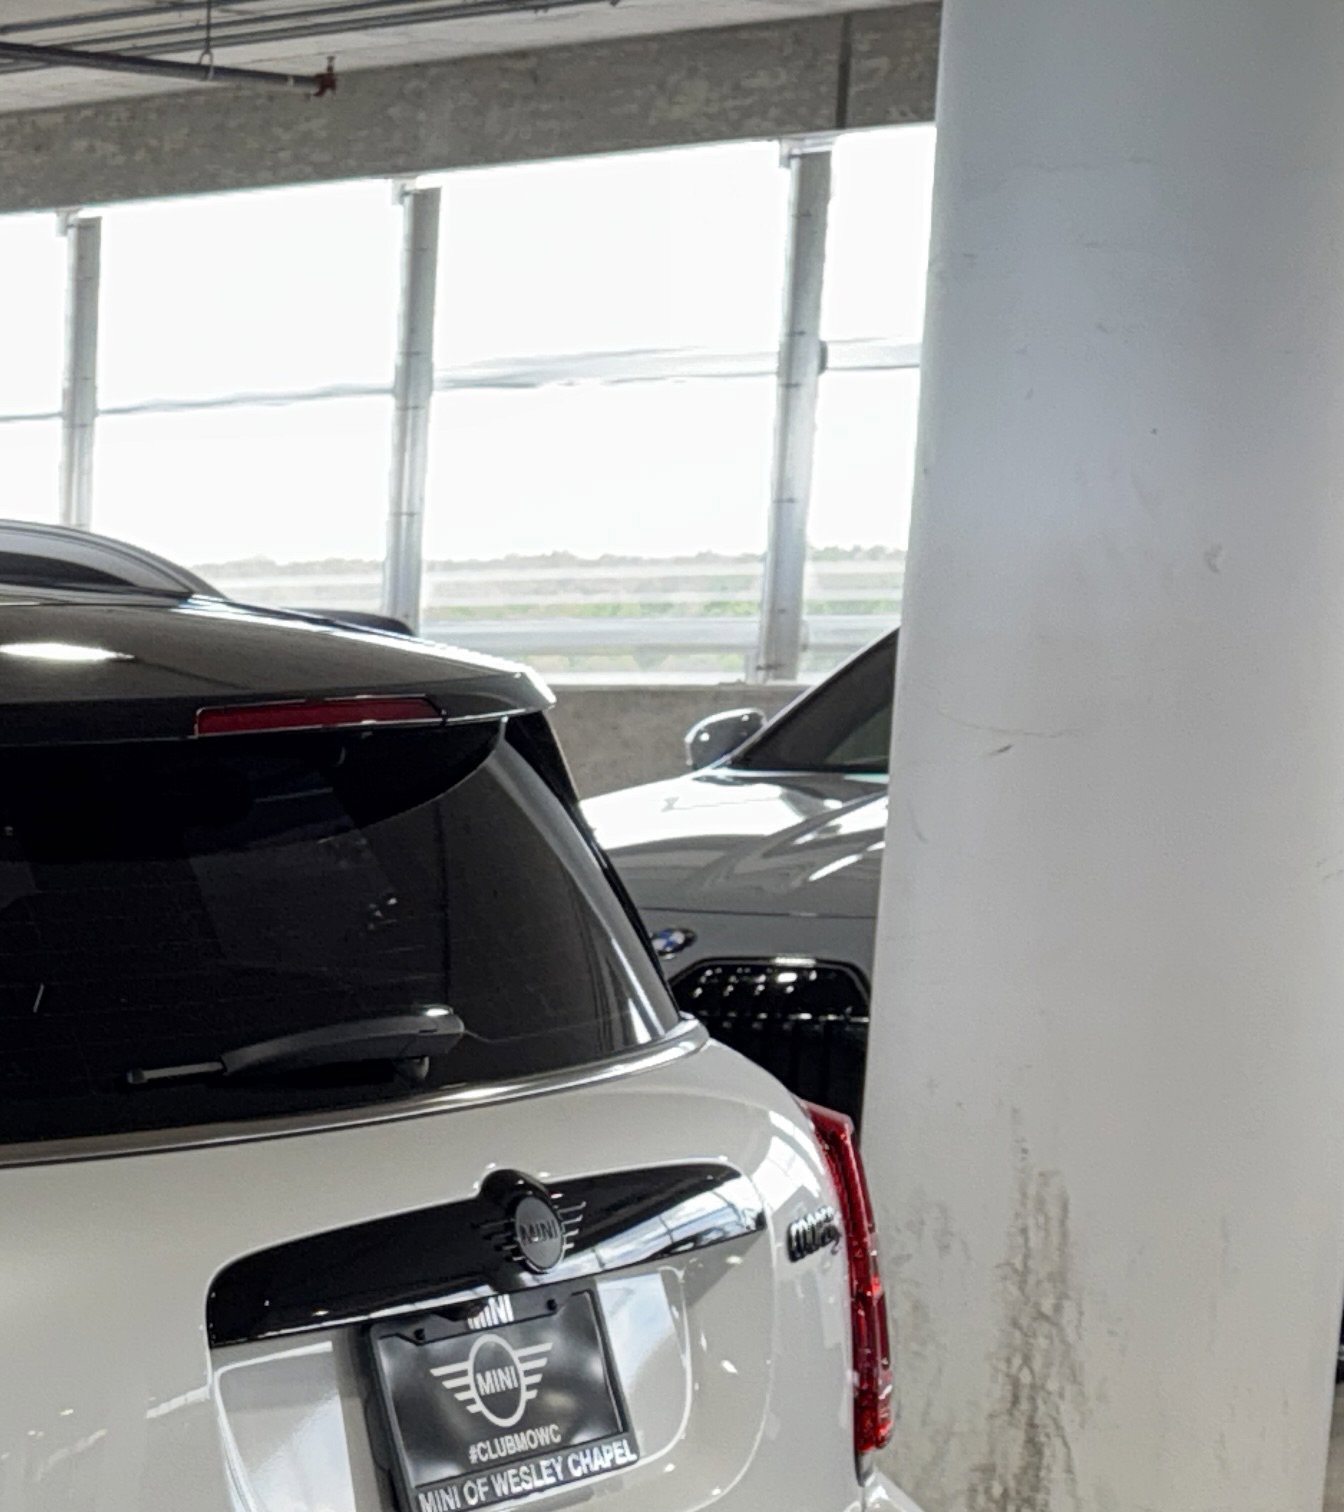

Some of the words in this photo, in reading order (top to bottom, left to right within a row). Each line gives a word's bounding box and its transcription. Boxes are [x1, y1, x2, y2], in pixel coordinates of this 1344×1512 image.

[519, 1219, 559, 1247] MINI
[475, 1365, 519, 1396] MINI
[468, 1423, 562, 1465] #CLUBMOWC
[463, 1479, 490, 1506] OF
[491, 1455, 564, 1498] WESLEY
[567, 1439, 638, 1478] CHAPEL
